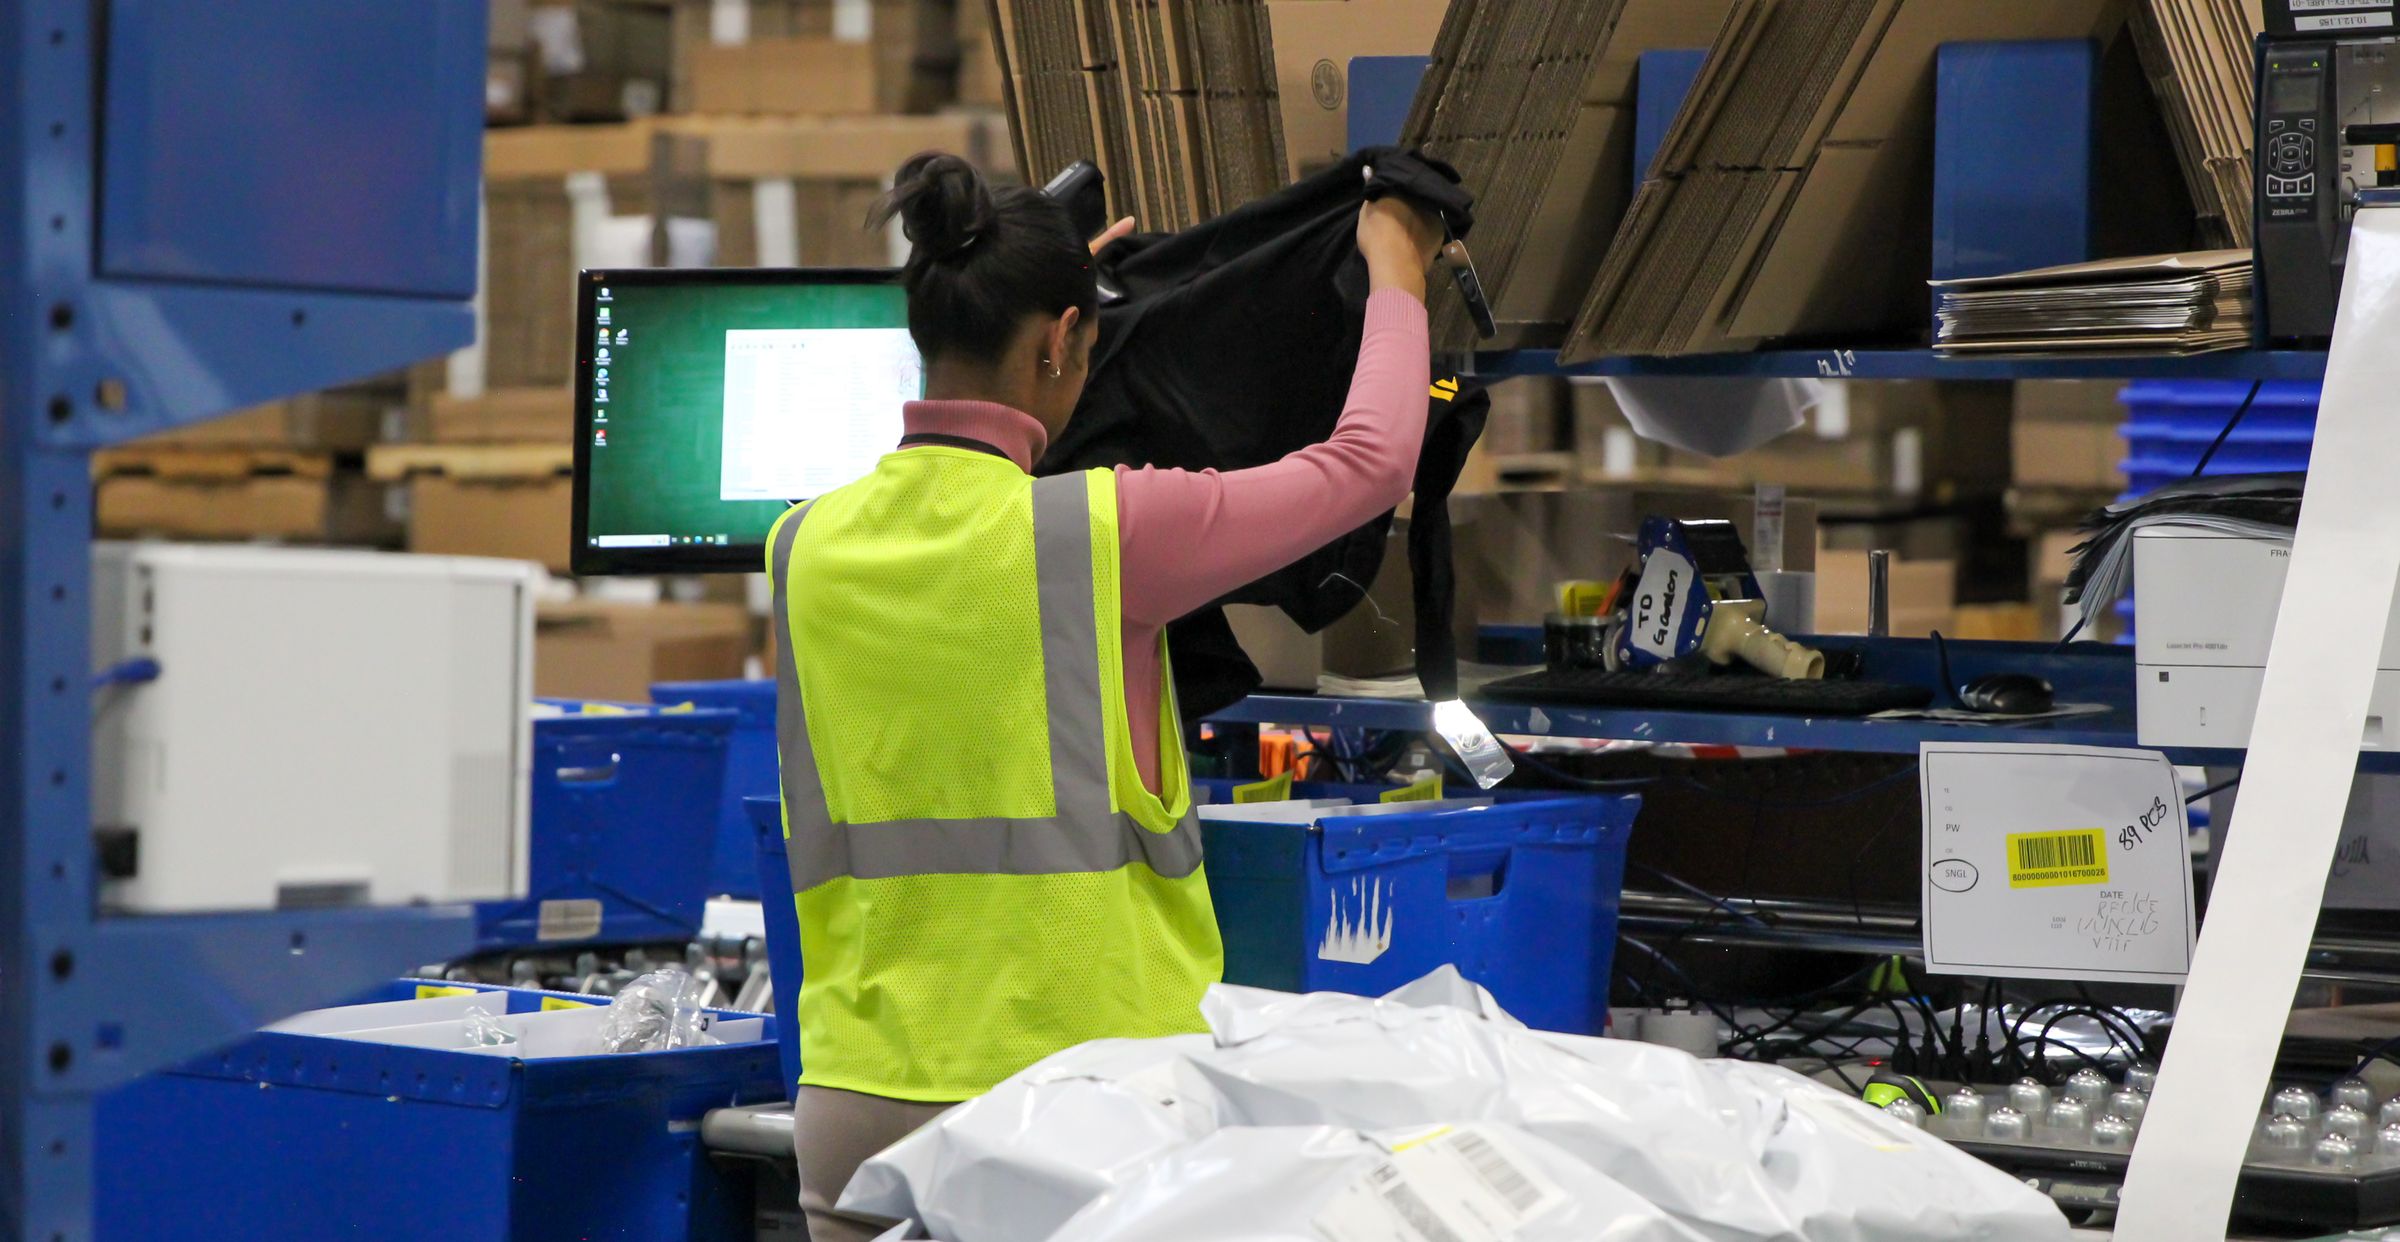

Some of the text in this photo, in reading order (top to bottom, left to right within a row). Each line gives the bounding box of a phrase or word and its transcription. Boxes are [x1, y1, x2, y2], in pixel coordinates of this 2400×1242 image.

[2272, 208, 2295, 216] ZEBRA
[1945, 824, 1961, 832] PW
[2118, 796, 2167, 851] 89 PCS
[1945, 869, 1967, 879] SNGL
[2100, 890, 2124, 899] DATE
